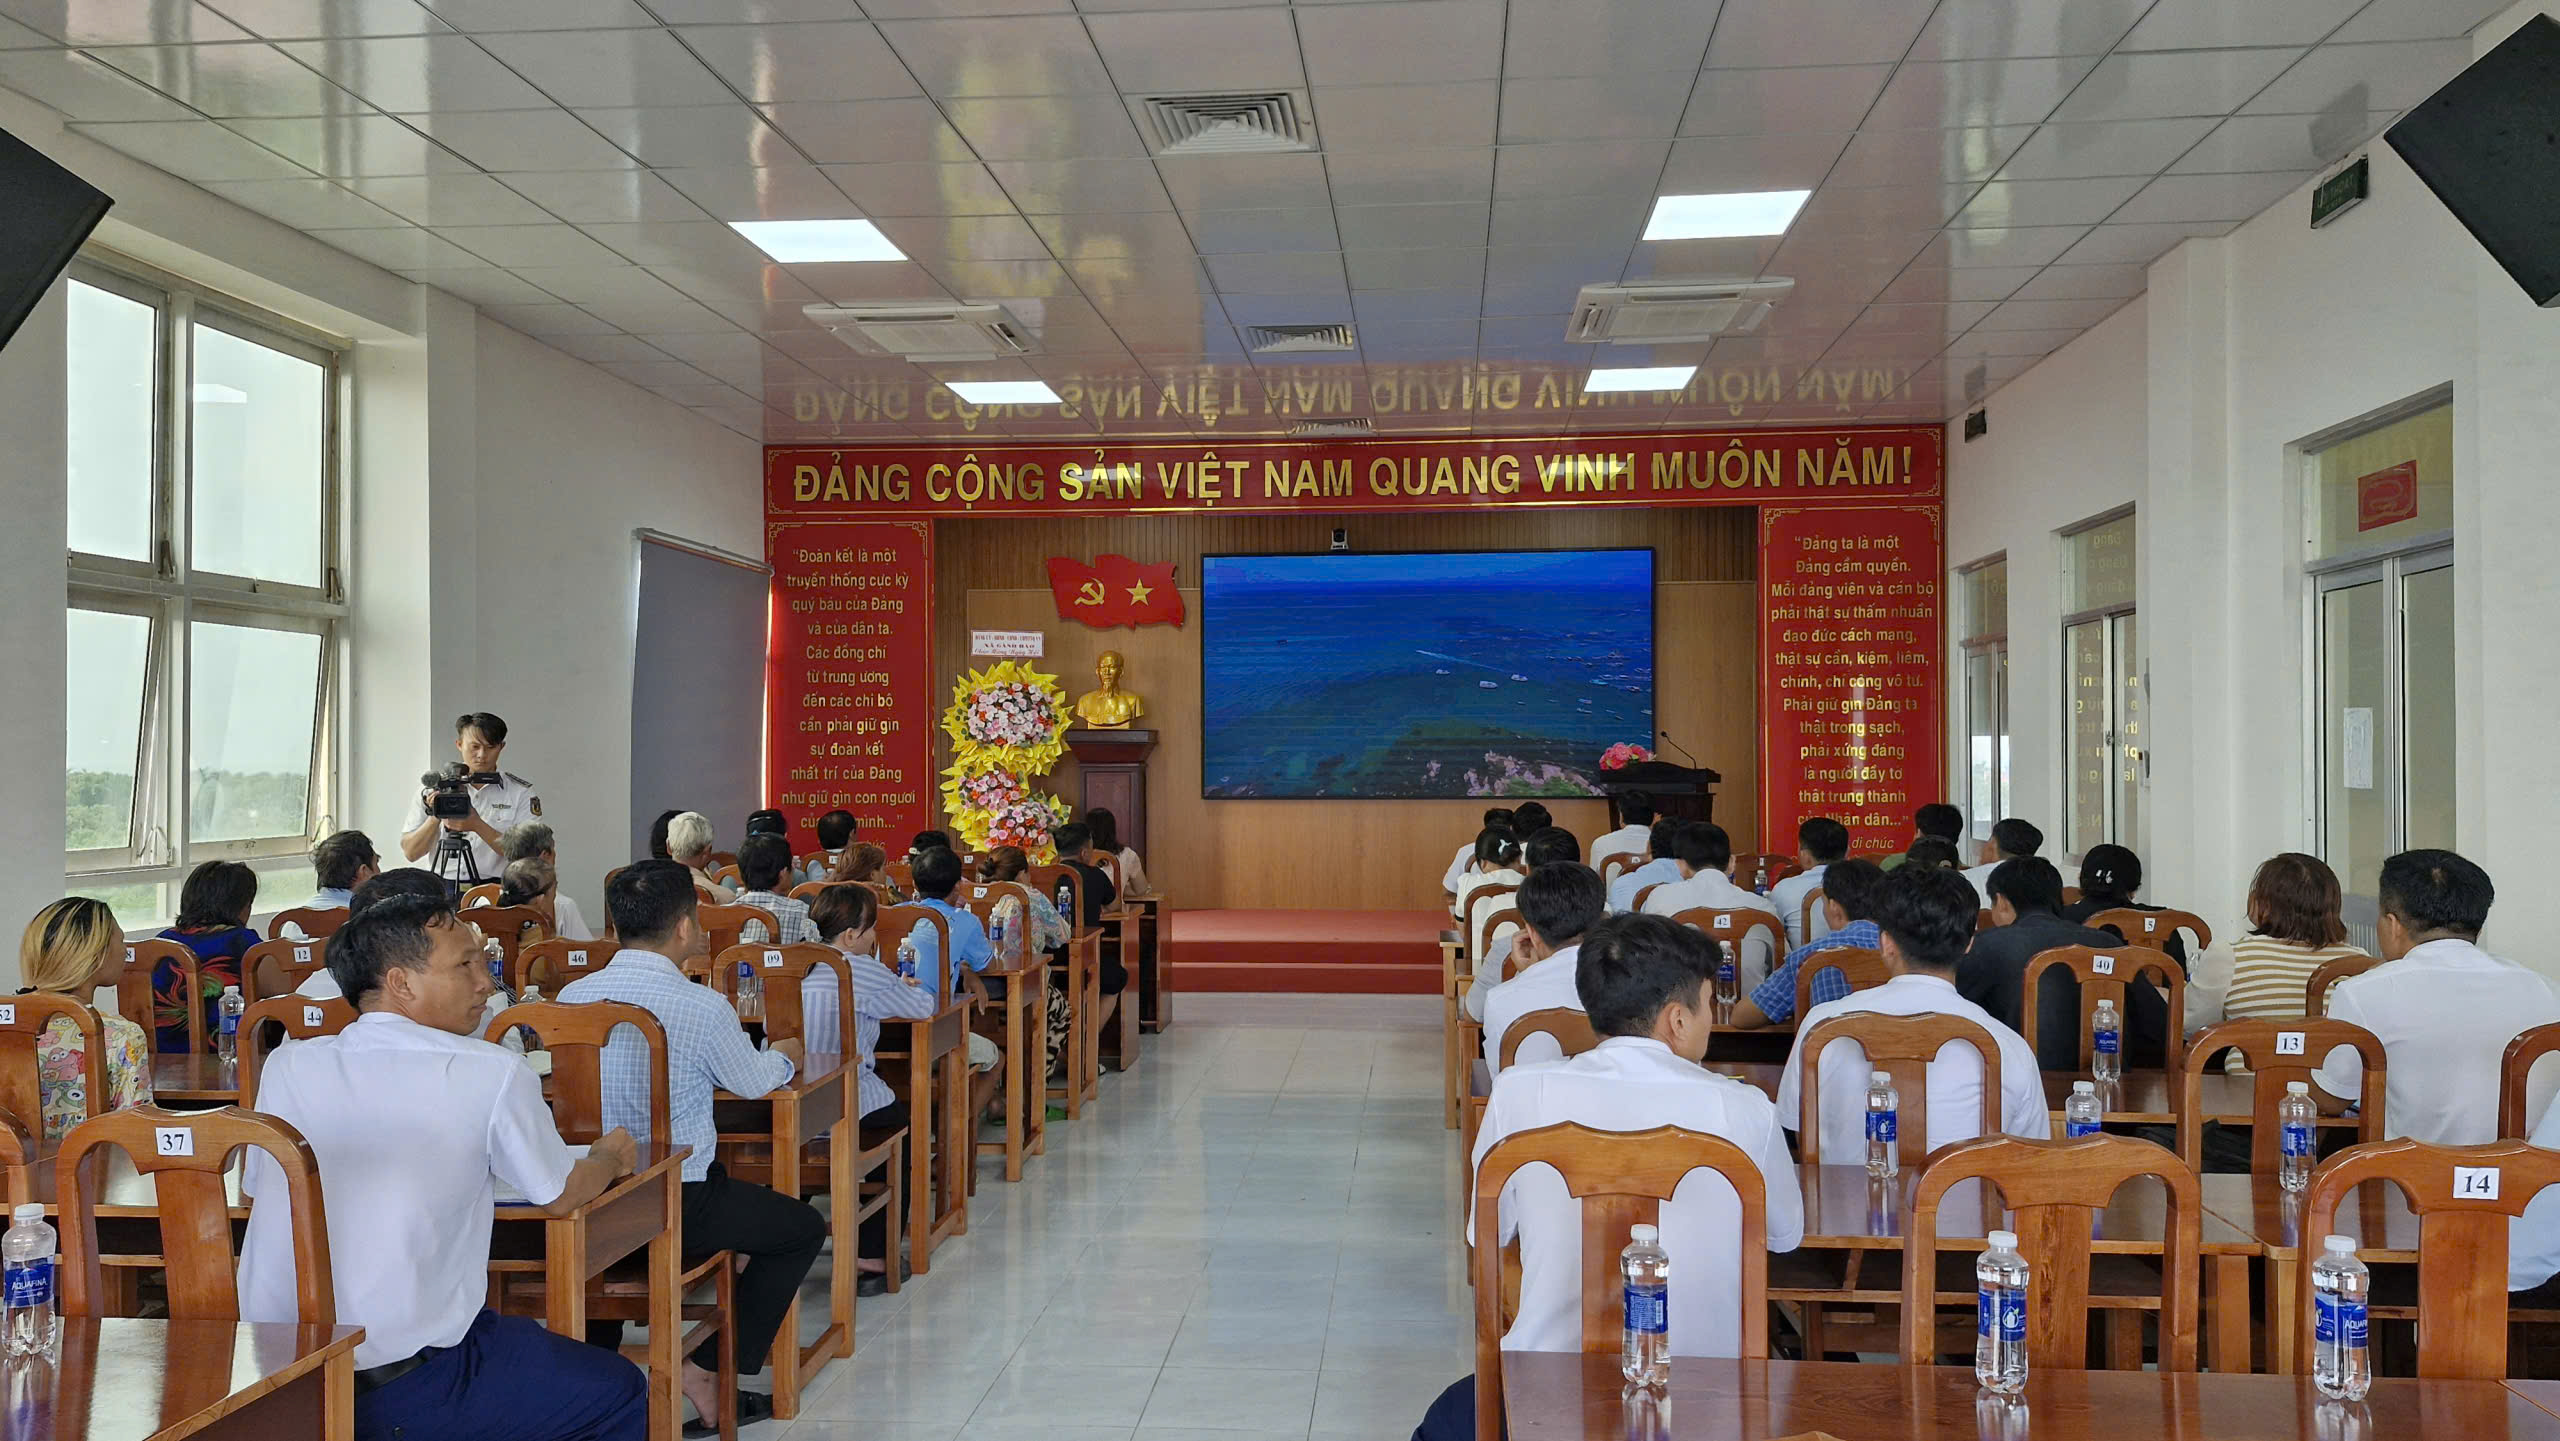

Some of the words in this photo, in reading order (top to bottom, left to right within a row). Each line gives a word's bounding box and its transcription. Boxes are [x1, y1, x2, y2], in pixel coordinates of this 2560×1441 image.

[794, 451, 911, 503] ĐẢNG
[925, 453, 1045, 509] CỘNG
[1059, 449, 1142, 500] SẢN
[1157, 452, 1250, 507] VIỆT
[1264, 459, 1353, 498] NAM
[1369, 455, 1521, 497] QUANG
[1540, 452, 1635, 493] VINH
[1651, 438, 1781, 491] MUÔN
[1797, 437, 1912, 486] NĂM!
[1841, 538, 1854, 550] ta
[1858, 536, 1869, 550] là
[1874, 536, 1900, 552] một
[835, 547, 853, 563] kết
[858, 549, 868, 563] là
[873, 548, 896, 565] một
[1796, 557, 1830, 576] Đảng
[1834, 557, 1862, 573] cầm
[1866, 557, 1911, 575] quyền.
[787, 572, 826, 589] truyền
[830, 571, 866, 590] thống
[869, 573, 891, 589] cực
[1771, 580, 1795, 597] Mỗi
[1800, 581, 1833, 599] đảng
[1837, 583, 1864, 596] viên
[1869, 581, 1884, 595] và
[1888, 580, 1912, 595] cán
[1916, 581, 1934, 598] bộ
[792, 597, 814, 613] quý
[819, 597, 842, 611] báu
[845, 595, 867, 611] của
[871, 594, 904, 614] Đảng
[1771, 604, 1800, 622] phải
[1804, 606, 1830, 622] thật
[1834, 609, 1850, 622] sự
[1853, 602, 1887, 618] thấm
[1891, 602, 1933, 618] nhuần
[807, 622, 821, 635] và
[826, 619, 848, 635] của
[851, 622, 874, 635] dân
[878, 622, 893, 635] ta.
[1783, 629, 1808, 645] đạo
[1811, 628, 1837, 642] đức
[1840, 628, 1872, 642] cách
[1876, 630, 1917, 644] mạng,
[806, 645, 829, 659] Các
[833, 643, 864, 662] đồng
[868, 645, 887, 659] chí
[1775, 651, 1801, 668] thật
[1805, 654, 1821, 668] sự
[1824, 650, 1853, 667] cần,
[1857, 651, 1892, 668] kiệm,
[1896, 651, 1929, 667] liêm,
[807, 669, 819, 683] từ
[823, 670, 855, 686] trung
[860, 671, 889, 686] ương
[1780, 674, 1822, 689] chính,
[1825, 674, 1846, 688] chí
[1849, 674, 1882, 690] công
[1887, 675, 1902, 687] vô
[1907, 675, 1924, 687] tư.
[802, 692, 826, 708] đến
[830, 694, 851, 708] các
[855, 694, 874, 708] chi
[877, 693, 894, 710] bộ
[1783, 695, 1813, 711] Phải
[1816, 698, 1838, 713] giữ
[1866, 695, 1901, 713] Đảng
[800, 716, 821, 731] cần
[827, 716, 853, 734] phải
[857, 718, 877, 734] giữ
[880, 717, 899, 734] gìn
[1800, 719, 1826, 737] thật
[1830, 721, 1865, 736] trong
[1869, 721, 1905, 737] sạch,
[810, 744, 825, 759] sự
[830, 742, 860, 756] đoàn
[865, 740, 884, 756] kết
[1800, 741, 1830, 760] phải
[1834, 742, 1867, 760] xứng
[1871, 743, 1905, 760] đáng
[791, 766, 818, 780] nhất
[824, 766, 838, 780] trí
[843, 764, 865, 780] của
[869, 764, 902, 783] Đảng
[1804, 767, 1815, 780] là
[1861, 764, 1885, 782] đầy
[781, 791, 806, 804] như
[809, 791, 829, 807] giữ
[832, 790, 850, 807] gìn
[855, 793, 877, 804] con
[1799, 789, 1825, 805] thật
[1828, 791, 1864, 806] trung
[1867, 789, 1906, 803] thành
[1852, 836, 1863, 849] di
[1865, 836, 1895, 849] chúc
[1716, 914, 1726, 924] 42
[297, 951, 307, 960] 12
[571, 954, 584, 964] 46
[767, 954, 780, 965] 09
[2096, 959, 2111, 971] 40
[2283, 1037, 2299, 1050] 13
[162, 1133, 185, 1151] 37
[2464, 1174, 2491, 1195] 14
[11, 1277, 48, 1291] AQUAFINA
